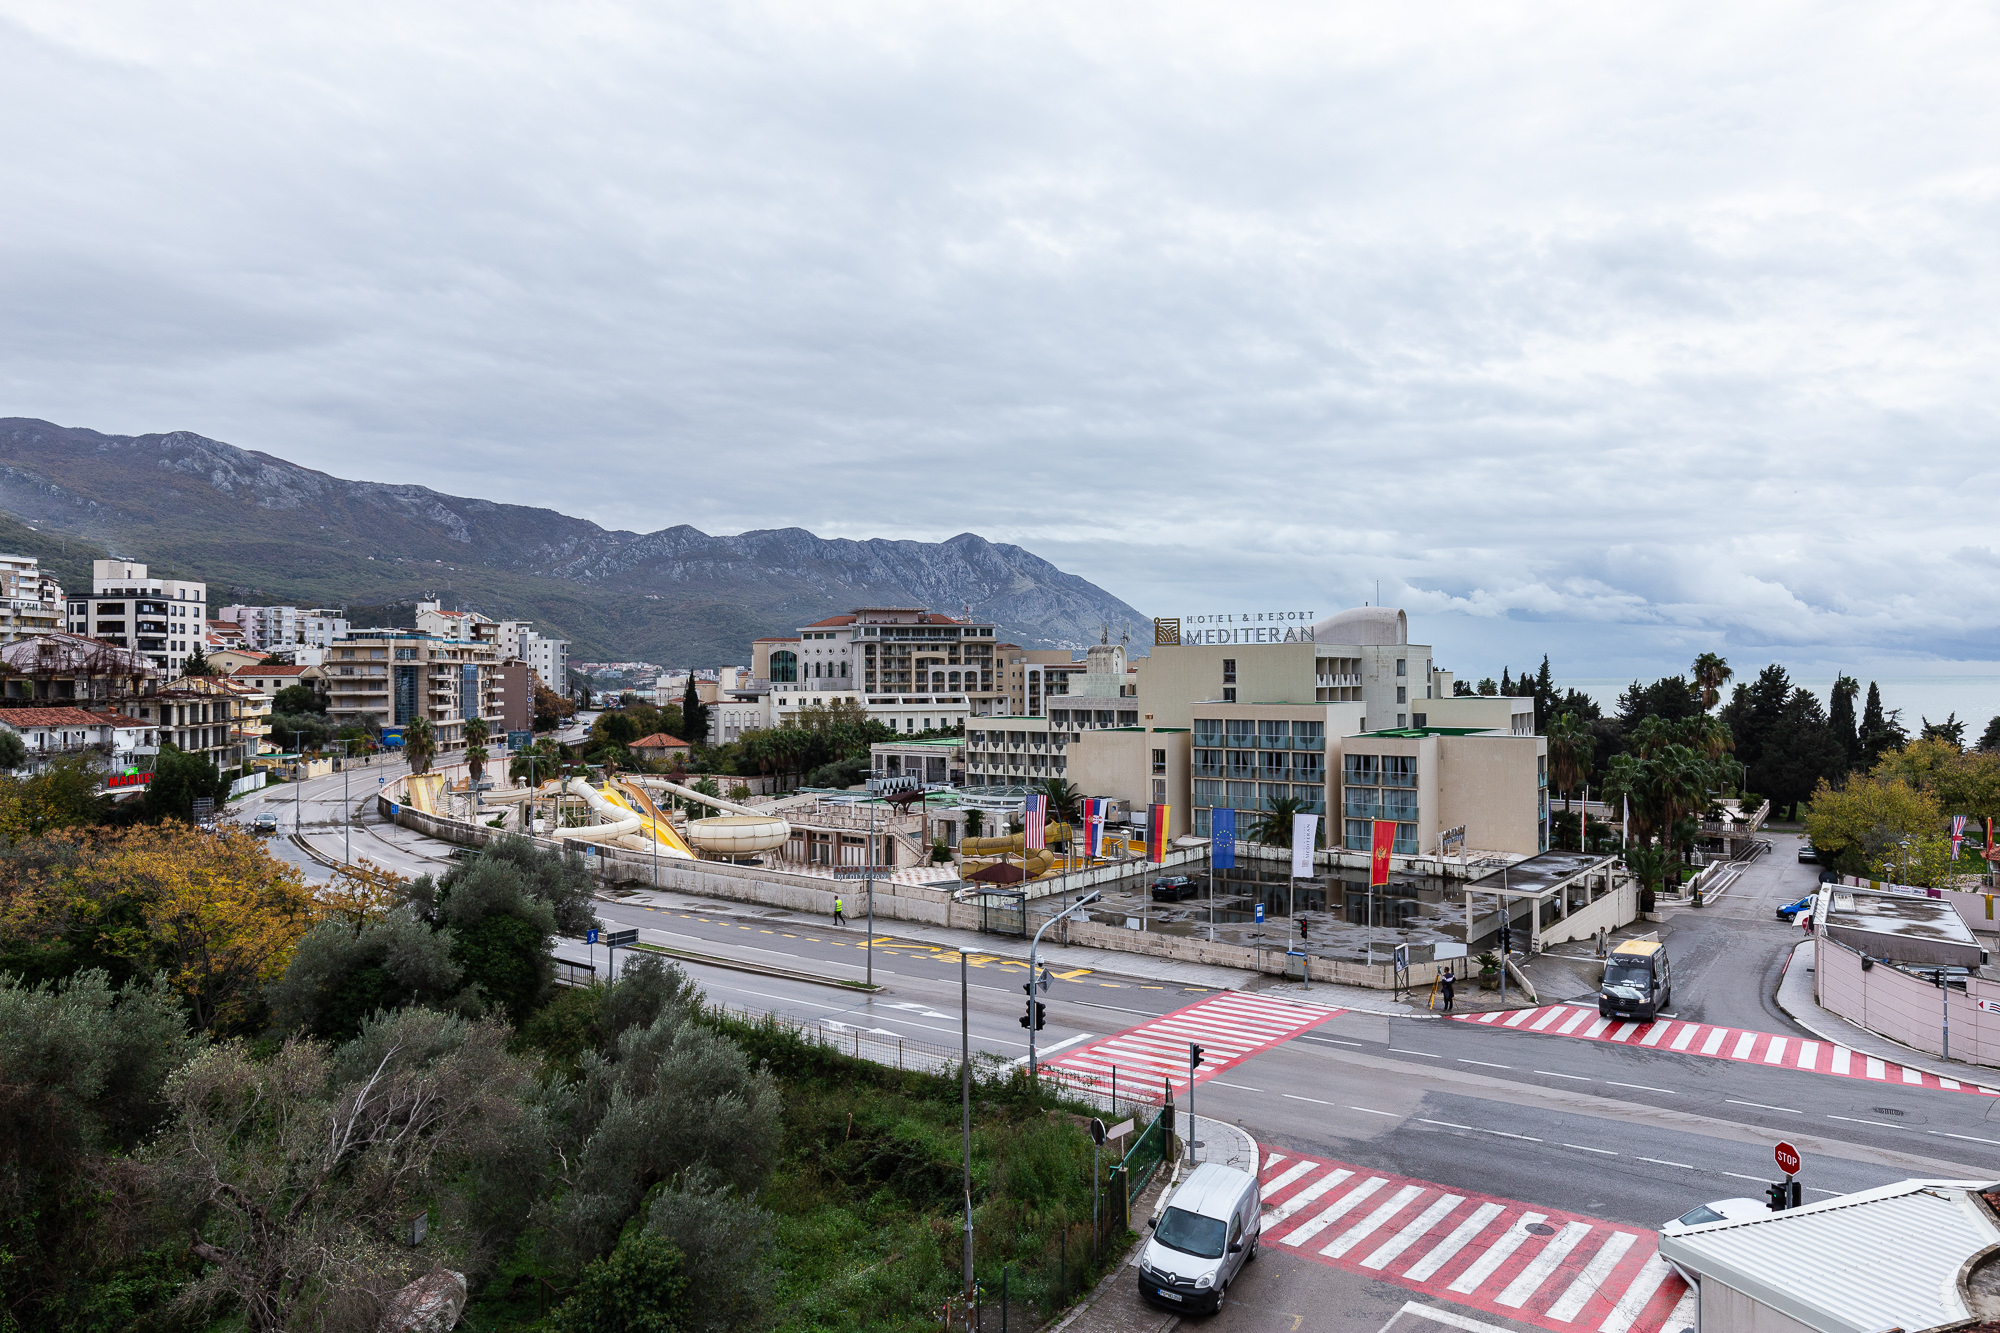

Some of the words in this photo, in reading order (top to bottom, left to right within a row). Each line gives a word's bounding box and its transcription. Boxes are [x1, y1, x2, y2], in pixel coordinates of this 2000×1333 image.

[1186, 614, 1233, 624] HOTEL
[1242, 613, 1250, 622] &
[1257, 611, 1315, 622] RESORT
[1186, 626, 1315, 645] MEDITERAN
[1777, 1150, 1798, 1167] STOP
